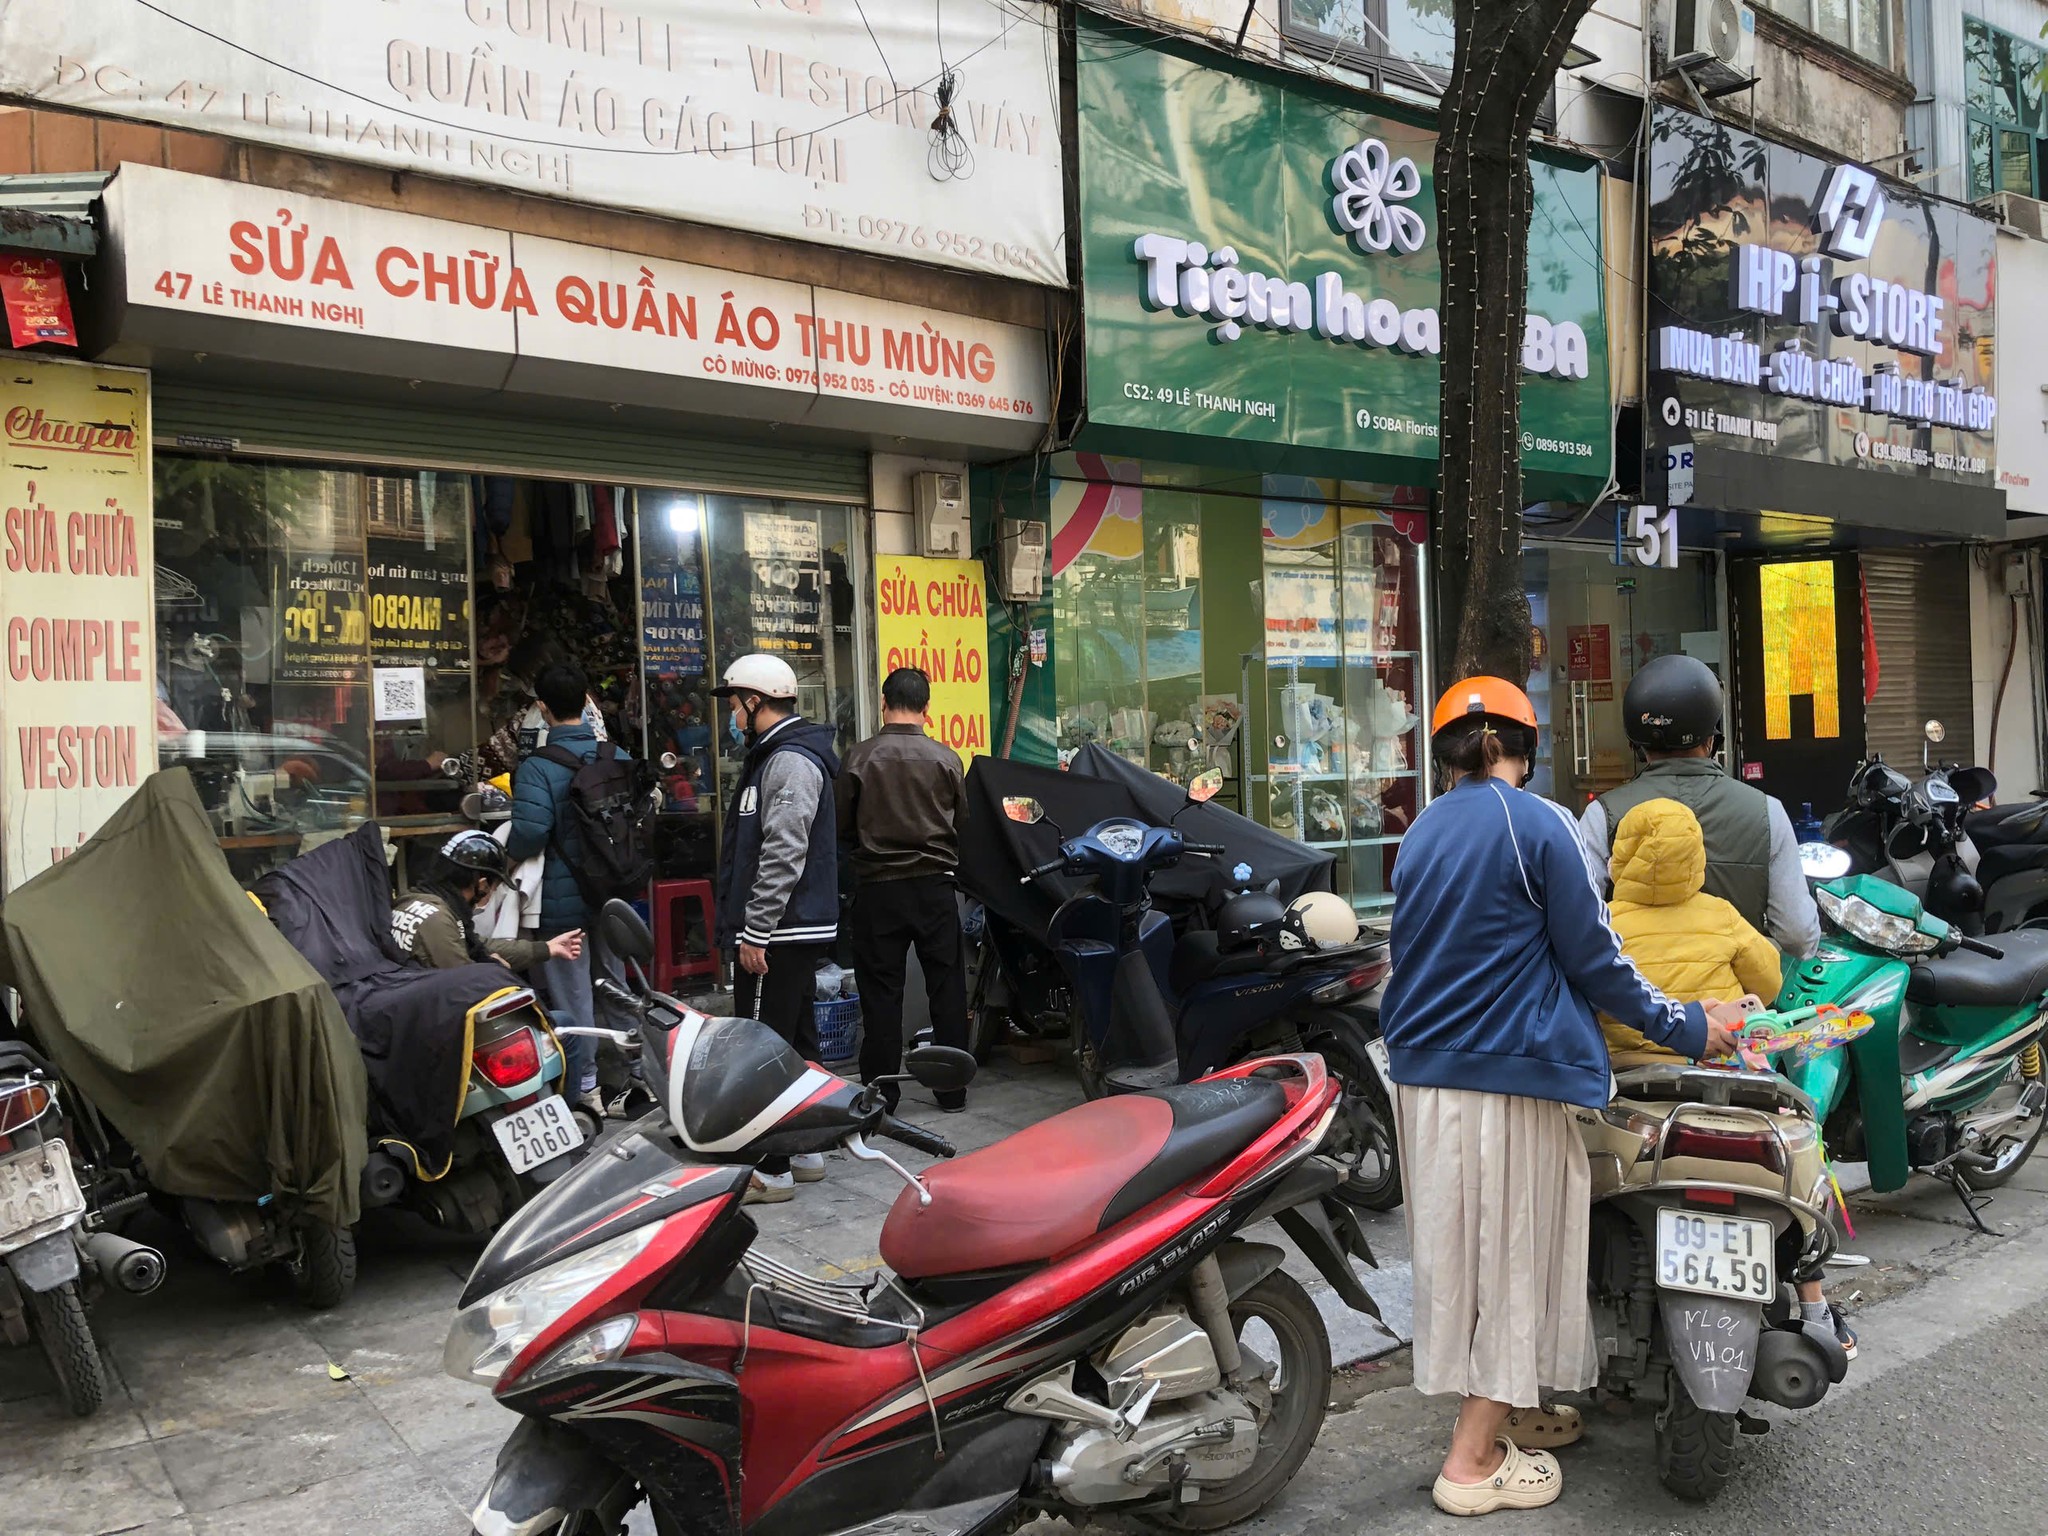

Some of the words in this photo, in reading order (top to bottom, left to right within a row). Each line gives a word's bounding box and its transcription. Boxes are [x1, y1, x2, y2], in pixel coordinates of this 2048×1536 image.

[386, 38, 542, 121] QUẦN
[558, 70, 628, 138] ÁO
[642, 95, 737, 161] CÁC
[751, 118, 847, 190] LOẠI
[748, 43, 927, 130] VESTON
[968, 98, 1041, 156] VÁY
[166, 79, 218, 113] 47
[242, 90, 288, 129] LÊ
[303, 104, 453, 162] THANH
[470, 139, 575, 192] NGHỊ
[858, 214, 927, 250] 0976
[935, 229, 987, 261] 952
[154, 271, 194, 300] 47
[202, 282, 223, 305] LÊ
[229, 289, 304, 318] THANH
[311, 300, 365, 330] NGHỊ
[229, 207, 354, 290] SỬA
[376, 246, 538, 316] CHỮA
[555, 265, 698, 340] QUẦN
[714, 290, 780, 351] ÁO
[794, 313, 870, 366] THU
[883, 321, 996, 384] MỪNG
[1134, 233, 1313, 344] Tiệm
[1315, 271, 1440, 356] hoa
[1739, 243, 1796, 316] HP
[702, 355, 728, 375] CÔ
[731, 356, 782, 382] MỪNG:
[785, 368, 819, 387] 0976
[823, 372, 848, 391] 952
[851, 375, 875, 394] 035
[889, 379, 910, 399] CÔ
[913, 382, 954, 406] LUYỆN:
[956, 391, 985, 410] 0369
[988, 395, 1010, 413] 645
[1012, 397, 1034, 416] 676
[1123, 382, 1154, 401] CS2:
[1156, 387, 1173, 404] 49
[1175, 387, 1191, 406] LÊ
[1195, 393, 1242, 414] THANH
[1245, 401, 1276, 423] NGHỊ
[1660, 325, 1713, 379] MUA
[1714, 331, 1760, 386] BÁN
[1771, 338, 1814, 397] SỬA
[1815, 356, 1865, 407] CHỮA
[1872, 361, 1902, 415] HỖ
[1903, 379, 1937, 428] TRỢ
[1938, 377, 1965, 428] TRẢ
[1965, 386, 1996, 430] GÓP
[4, 405, 137, 451] Chuyên
[1372, 415, 1403, 432] SOBA
[1405, 419, 1438, 438] Florist
[1536, 439, 1558, 452] 0896
[1559, 441, 1575, 455] 913
[1576, 443, 1593, 457] 584
[1684, 408, 1699, 428] 51
[1701, 407, 1715, 431] LÊ
[1717, 412, 1751, 437] THANH
[1753, 419, 1778, 446] NGHỊ
[5, 480, 61, 574] SỬA
[68, 497, 139, 577] CHỮA
[1633, 505, 1678, 568] 51
[880, 565, 919, 616] SỬA
[926, 574, 984, 618] CHỮA
[8, 616, 142, 682] COMPLE
[952, 638, 982, 683] ÁO
[18, 725, 137, 790] VESTON
[940, 713, 984, 758] LOẠI
[1235, 982, 1285, 997] VISION
[505, 1102, 562, 1144] 29-Y9
[516, 1125, 571, 1167] 2060
[1118, 1263, 1156, 1296] AIR
[1161, 1209, 1231, 1267] BLADE
[1674, 1215, 1753, 1257] 89-E1
[1663, 1249, 1768, 1296] 564.59
